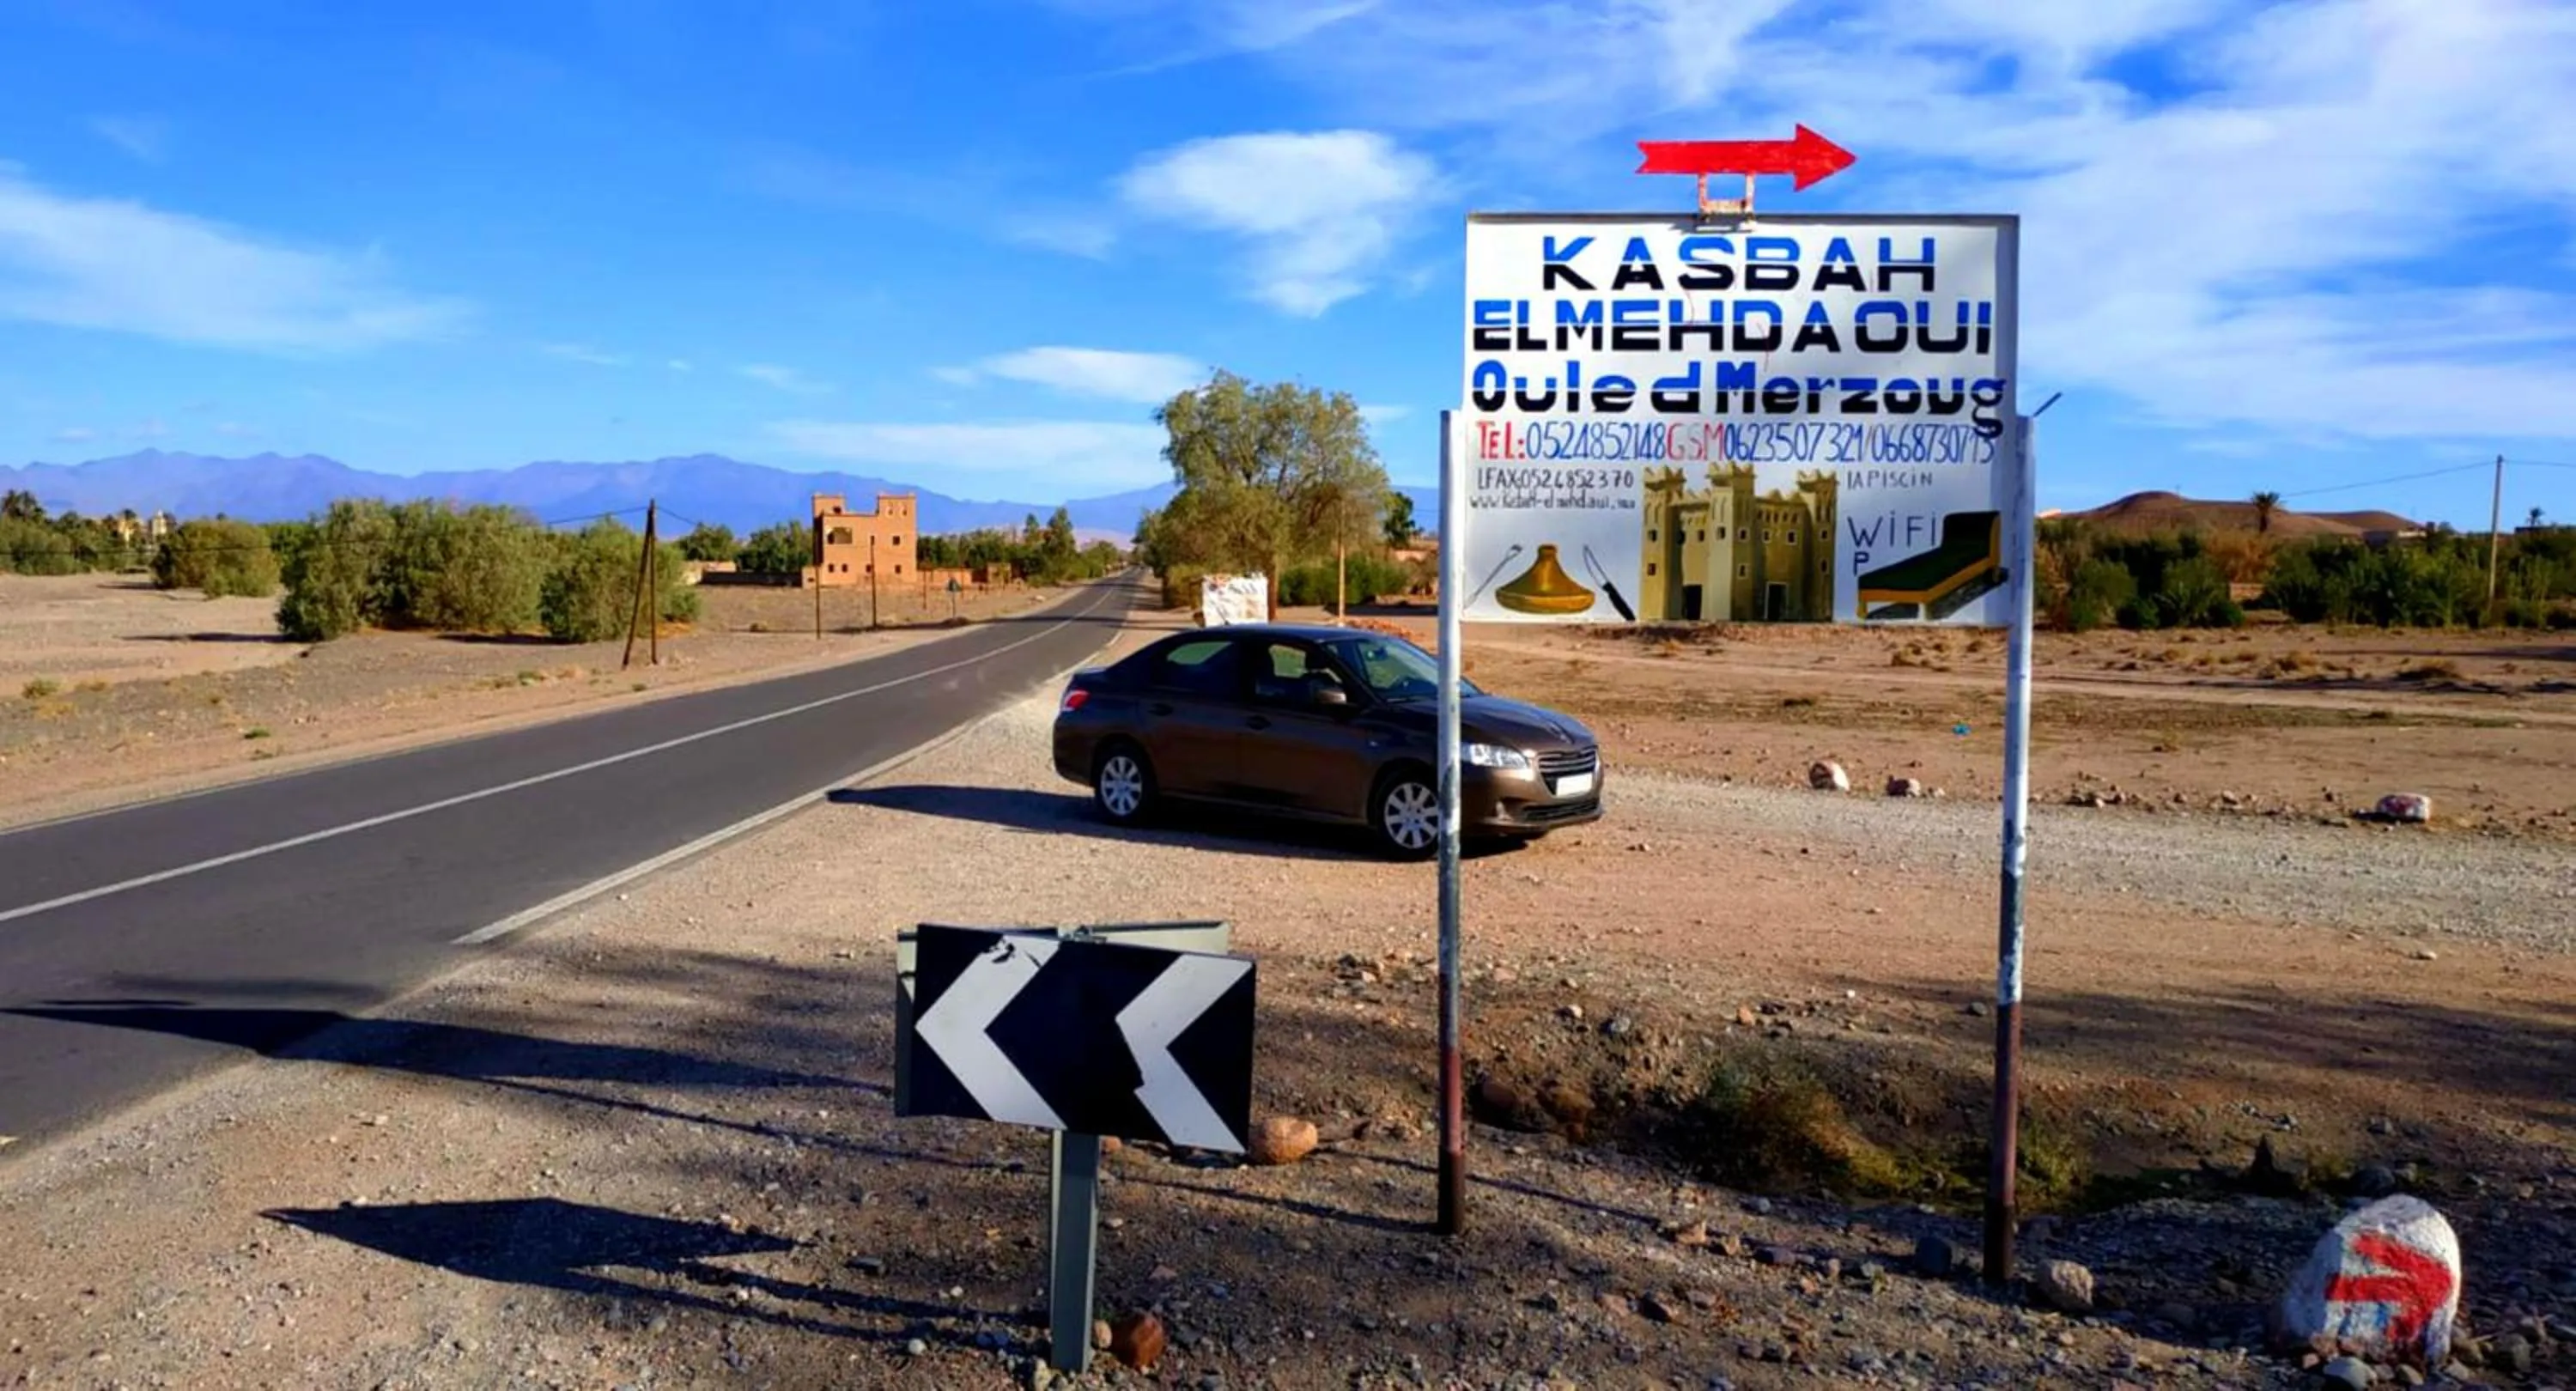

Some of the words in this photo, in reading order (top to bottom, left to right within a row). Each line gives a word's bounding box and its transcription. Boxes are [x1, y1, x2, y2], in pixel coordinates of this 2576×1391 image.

[1542, 236, 1935, 293] KASBAH
[1472, 359, 1701, 414] Ouled
[1716, 361, 2006, 439] Merzoug
